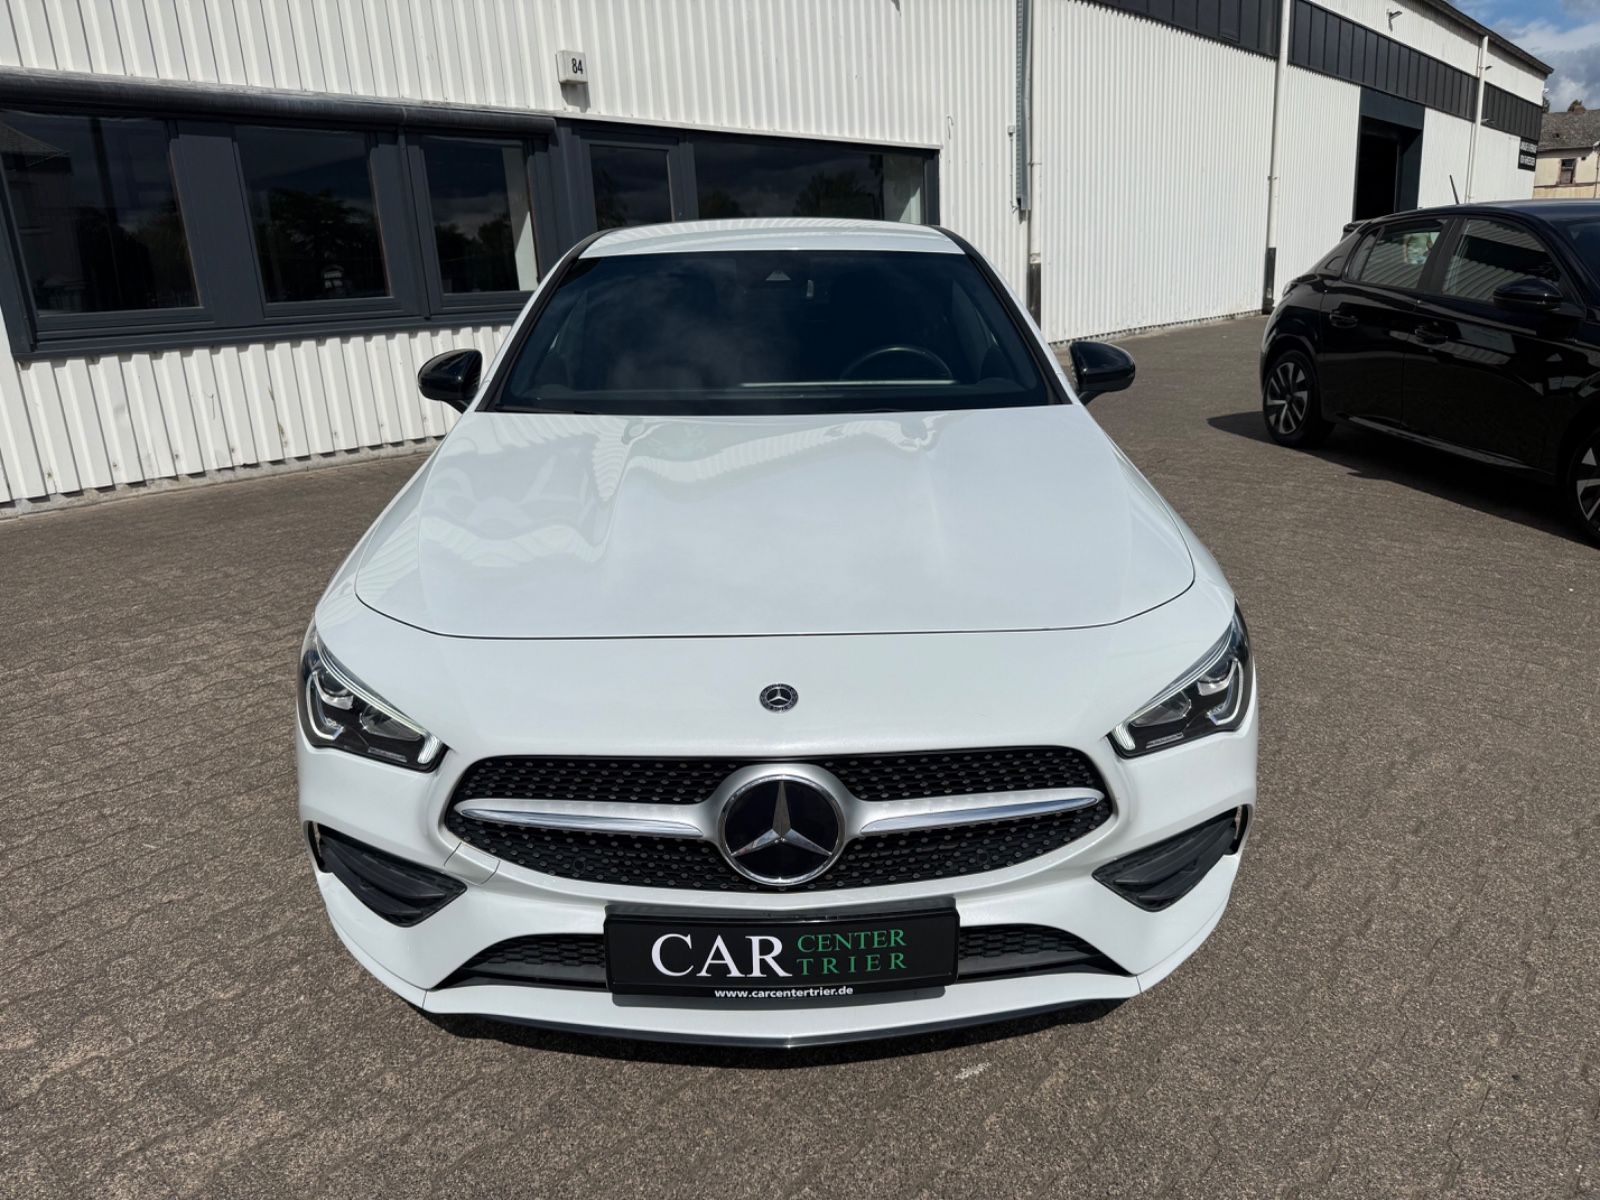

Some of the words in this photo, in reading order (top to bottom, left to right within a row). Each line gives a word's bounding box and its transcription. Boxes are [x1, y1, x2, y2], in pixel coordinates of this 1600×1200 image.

[571, 57, 584, 75] 84
[651, 933, 793, 978] CAR
[796, 928, 907, 953] CENTER
[796, 952, 907, 976] TRIER
[714, 985, 854, 998] www.carcentertrier.de
